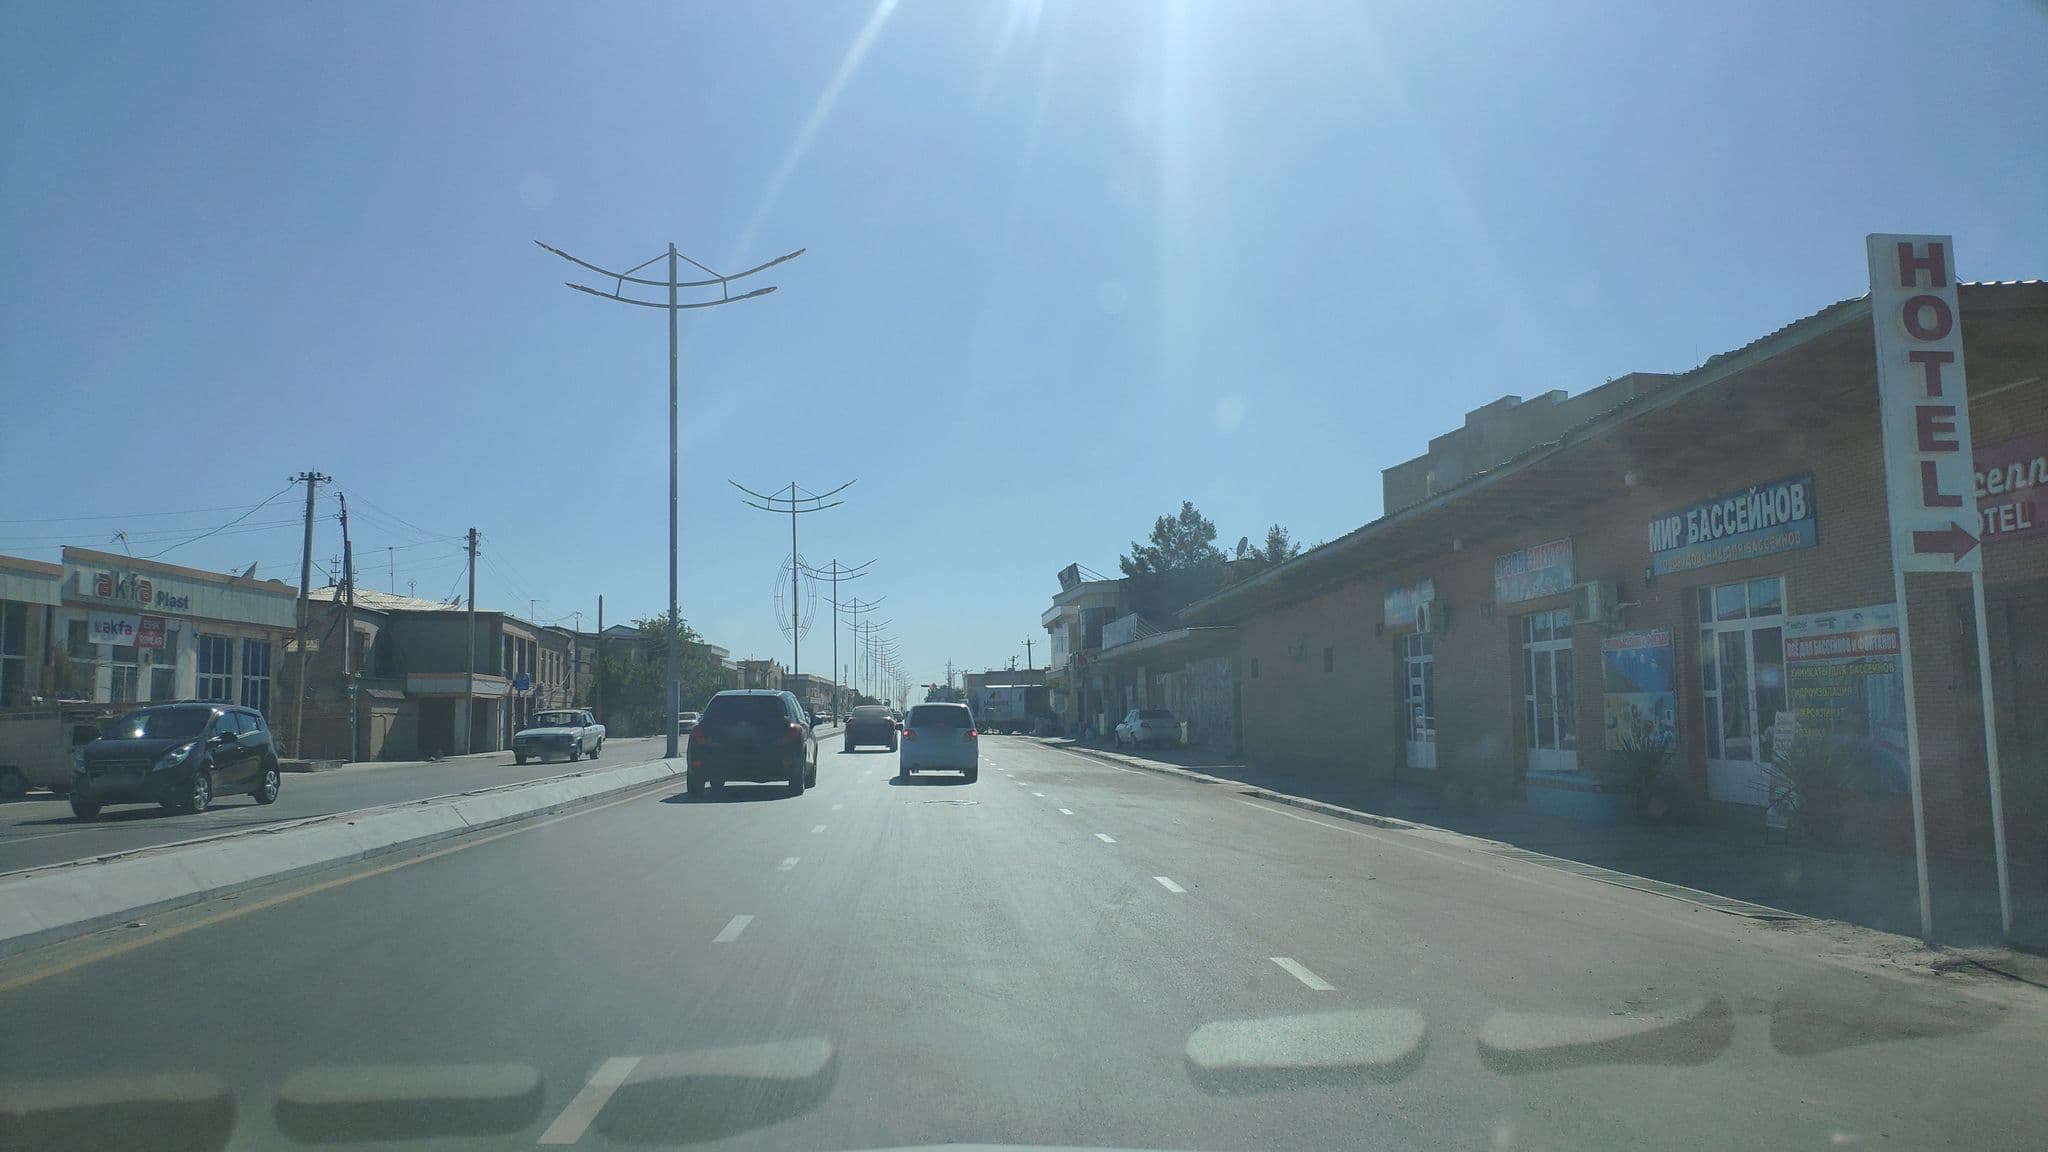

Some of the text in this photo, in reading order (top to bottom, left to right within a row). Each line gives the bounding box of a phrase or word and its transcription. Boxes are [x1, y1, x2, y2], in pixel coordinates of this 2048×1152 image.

[1898, 242, 1963, 508] HOTEL
[1648, 483, 1806, 552] МИР БАССЕЙНОВ
[95, 571, 190, 609] akfa Plast
[103, 618, 132, 635] akfa
